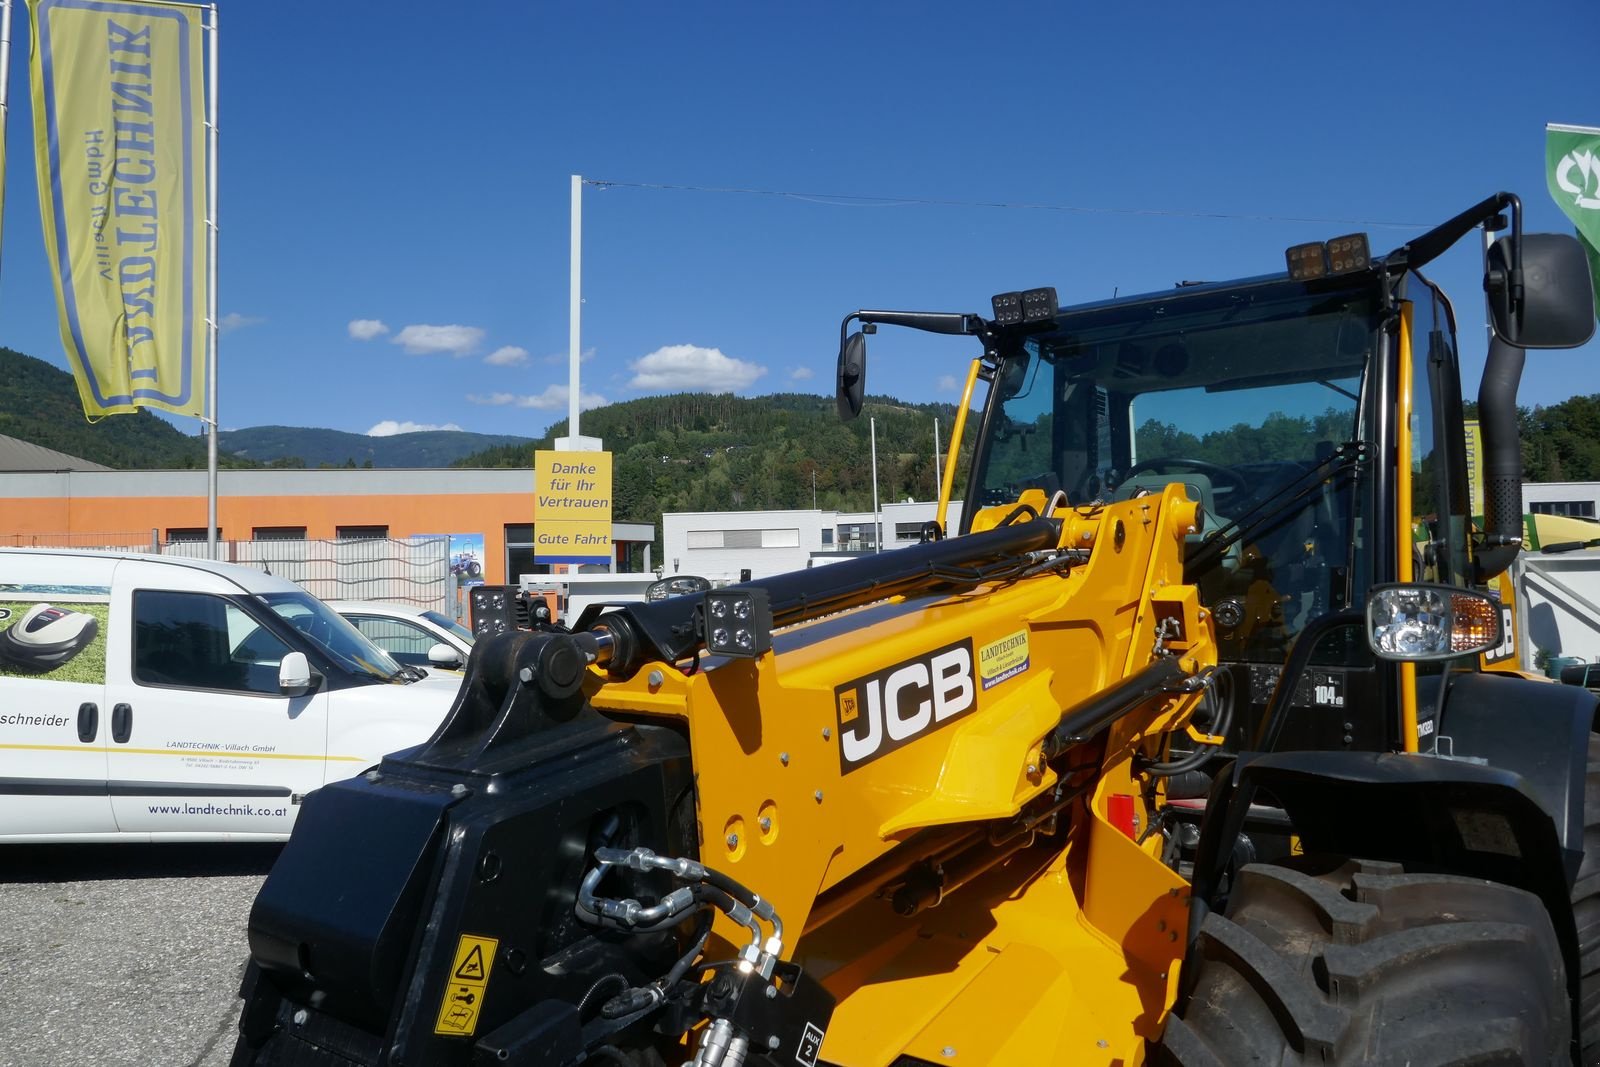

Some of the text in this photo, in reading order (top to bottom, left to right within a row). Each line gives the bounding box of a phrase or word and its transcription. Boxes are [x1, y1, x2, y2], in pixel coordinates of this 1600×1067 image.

[551, 463, 596, 475] Danke
[550, 478, 595, 491] für Ihr
[539, 496, 609, 508] Vertrauen
[538, 533, 608, 545] Gute Fahrt
[981, 633, 1026, 662] LANDTECHNIK
[842, 647, 974, 762] JCB
[0, 713, 70, 727] schneider
[252, 744, 276, 752] GmbH
[148, 802, 287, 817] www.landtechnik.co.at
[805, 1031, 821, 1046] AUX
[805, 1044, 813, 1057] 2
